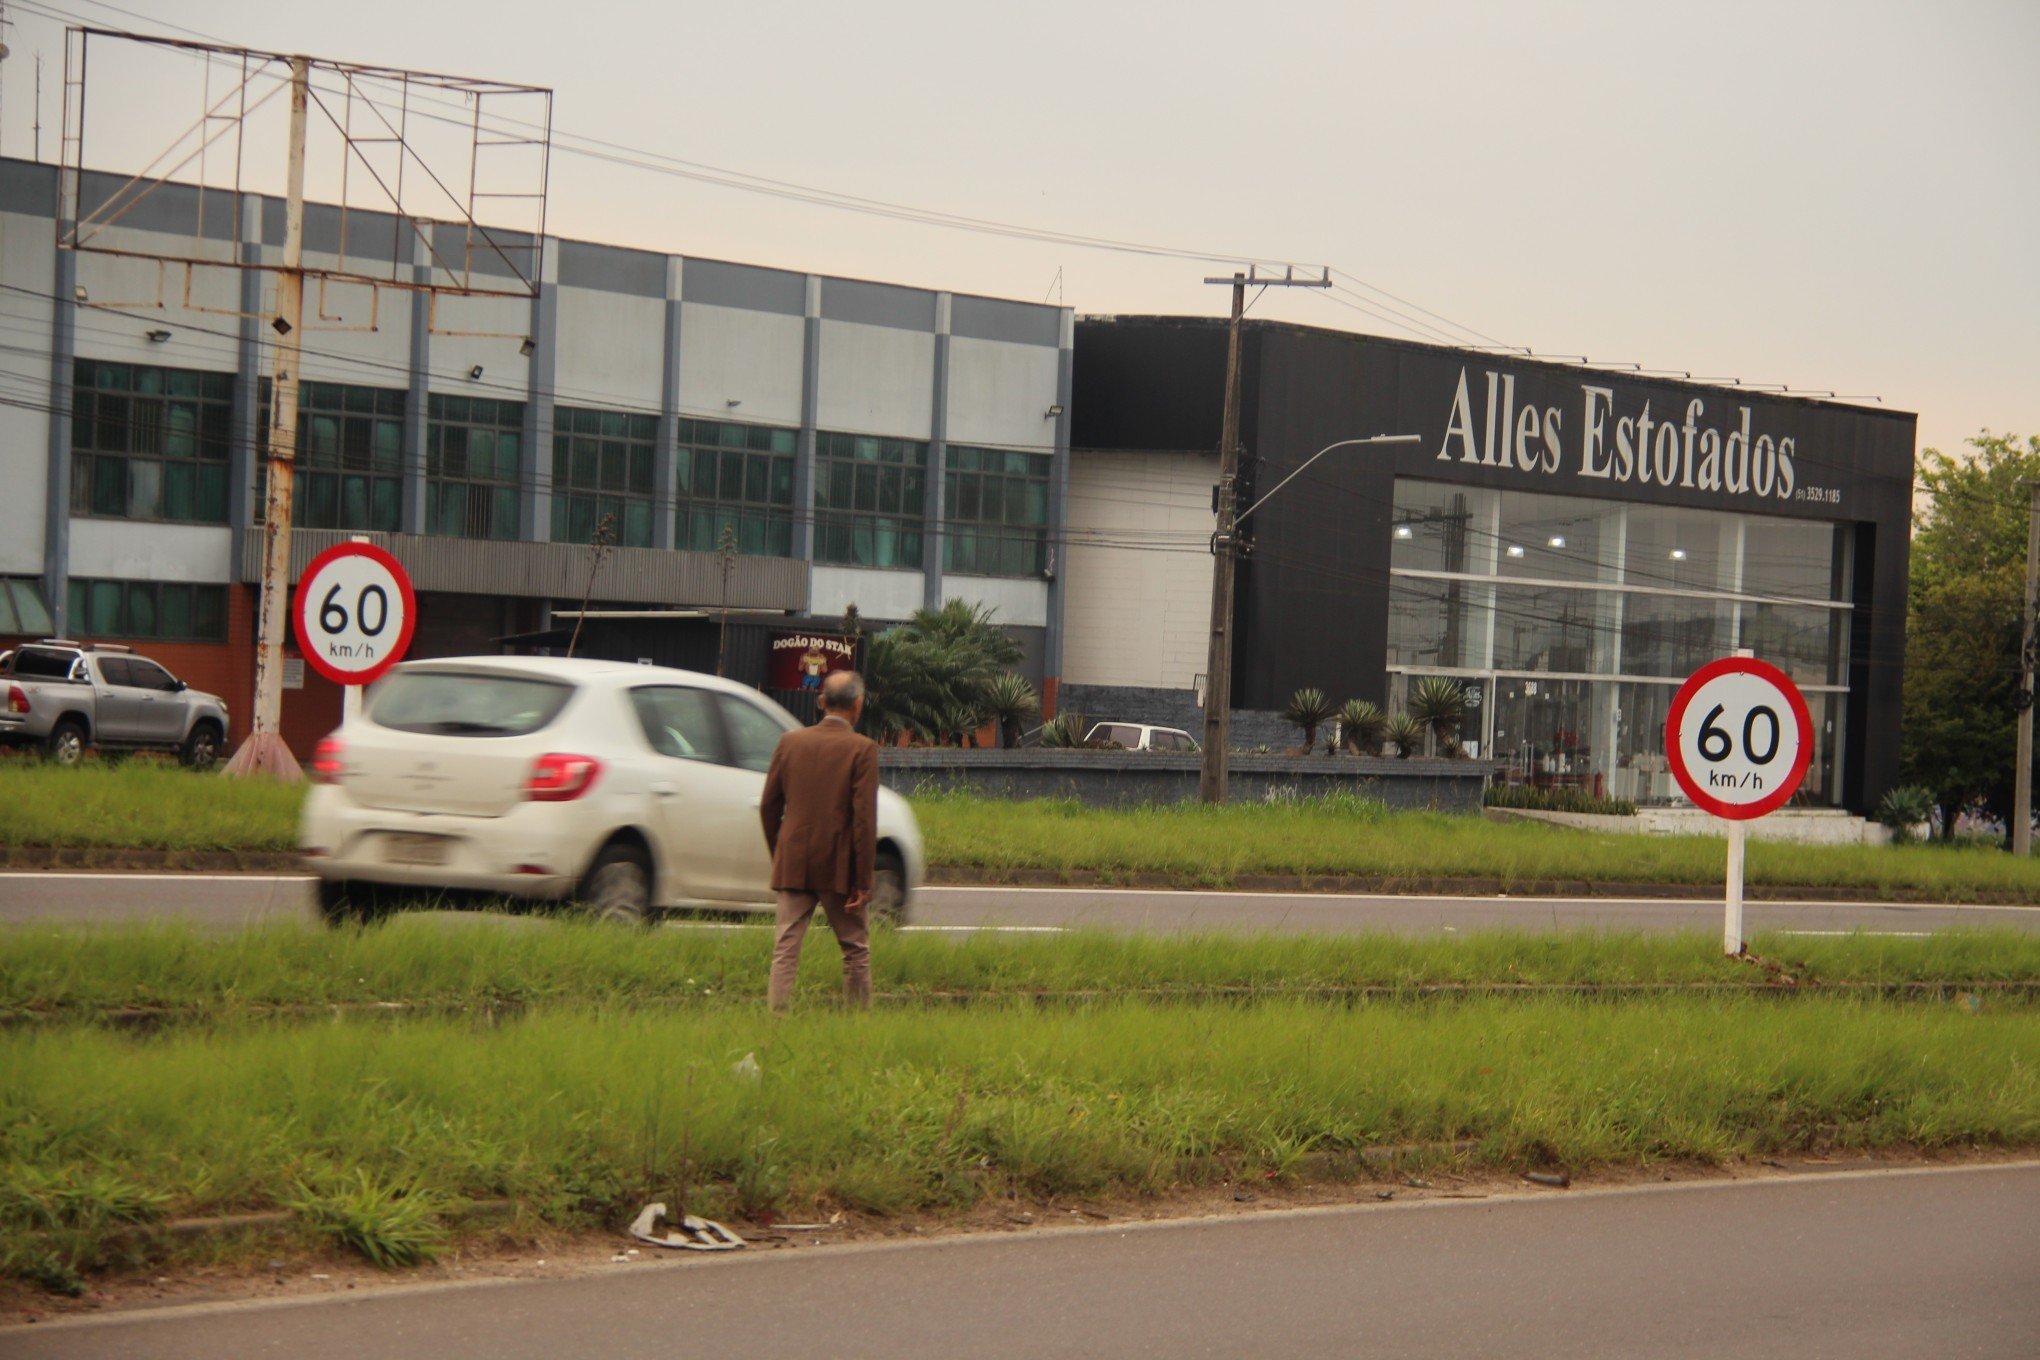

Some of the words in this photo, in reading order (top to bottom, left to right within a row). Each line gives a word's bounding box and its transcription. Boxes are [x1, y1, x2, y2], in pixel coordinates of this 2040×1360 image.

[1437, 366, 1562, 474] Alles
[1577, 385, 1795, 499] Estofados
[319, 583, 388, 637] 60
[329, 642, 374, 658] km/h
[773, 635, 808, 650] DOGÃO
[810, 637, 824, 649] DO
[1697, 703, 1780, 766] 60
[1709, 769, 1762, 789] km/h
